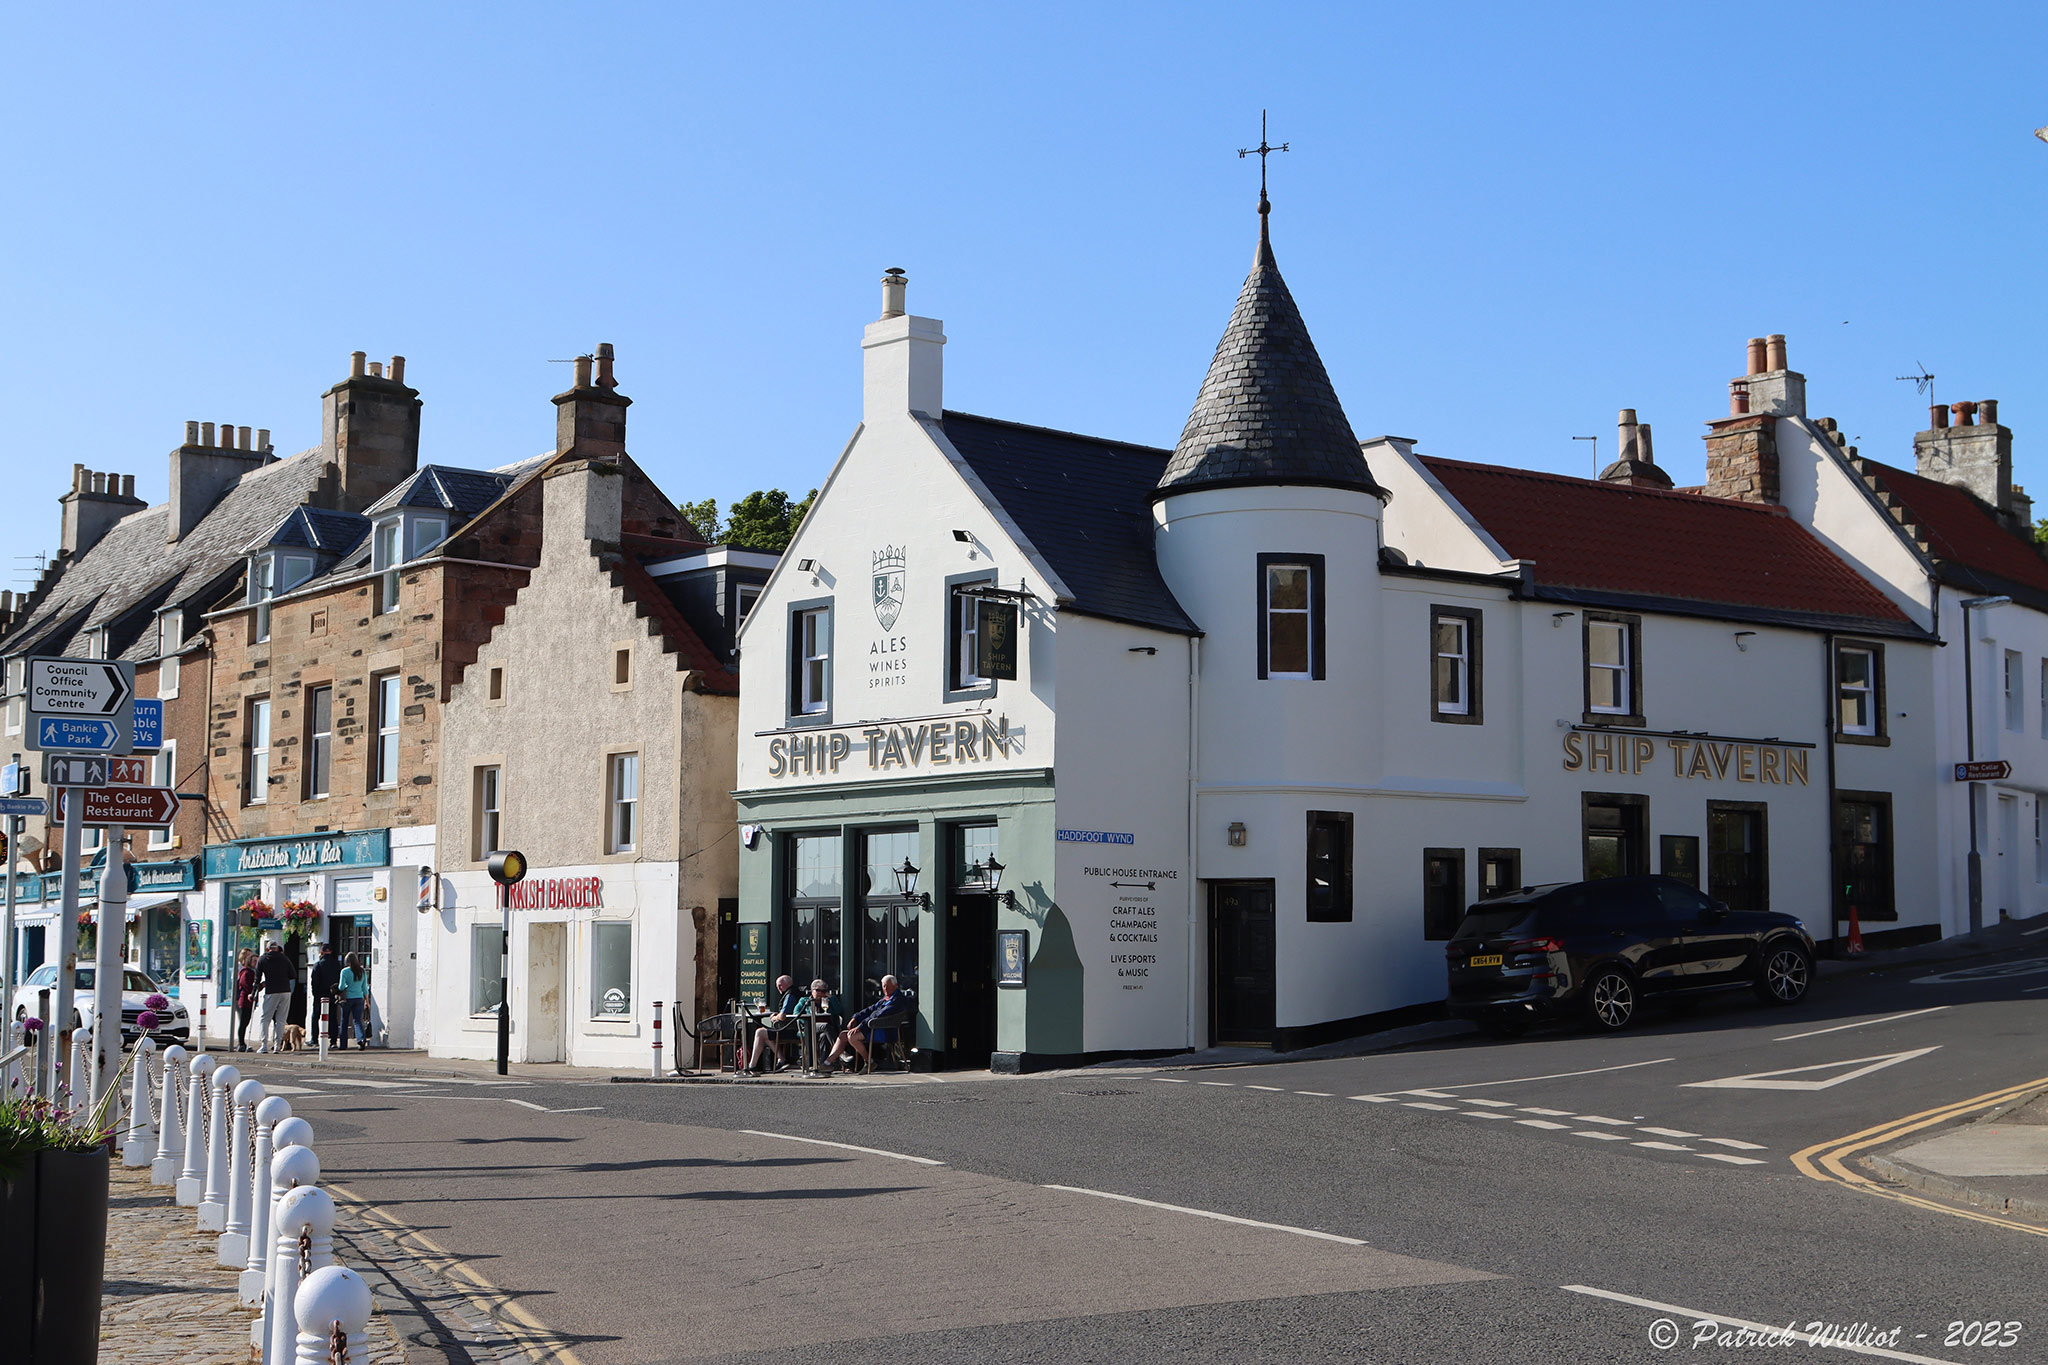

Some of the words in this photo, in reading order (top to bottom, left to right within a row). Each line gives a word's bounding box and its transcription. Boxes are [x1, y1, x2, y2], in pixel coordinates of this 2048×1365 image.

[870, 636, 907, 655] ALES
[988, 652, 1006, 662] SHIP
[47, 665, 88, 676] Council
[869, 658, 907, 673] WINES
[982, 661, 1011, 671] TAVERN
[51, 676, 83, 687] Office
[869, 675, 906, 689] SPIRITS
[36, 687, 98, 699] Community
[48, 699, 85, 709] Centre
[62, 723, 98, 733] Bankie
[68, 734, 92, 744] Park
[768, 732, 849, 777] SHIP
[862, 716, 1010, 770] TAVERN
[1563, 732, 1655, 775] SHIP
[1669, 739, 1810, 786] TAVERN
[88, 792, 110, 803] The
[115, 793, 153, 804] Cellar
[86, 805, 153, 818] Restaurant
[1057, 830, 1104, 843] HADDFOOT
[1107, 832, 1133, 844] WYND
[238, 847, 291, 871] Anstruther
[294, 841, 318, 868] Fish
[321, 840, 342, 863] Bar
[1084, 867, 1111, 876] PUBLIC
[1112, 868, 1137, 877] HOUSE
[1139, 869, 1177, 879] ENTRANCE
[548, 876, 601, 908] BARBER
[1113, 906, 1136, 915] CRAFT
[1138, 907, 1155, 916] ALES
[1110, 920, 1157, 929] CHAMPAGNE
[1110, 933, 1116, 942] &
[1117, 933, 1158, 943] COCKTAILS
[1111, 955, 1127, 963] LIVE
[1128, 955, 1156, 964] SPORTS
[1118, 969, 1124, 977] &
[1125, 968, 1149, 977] MUSIC
